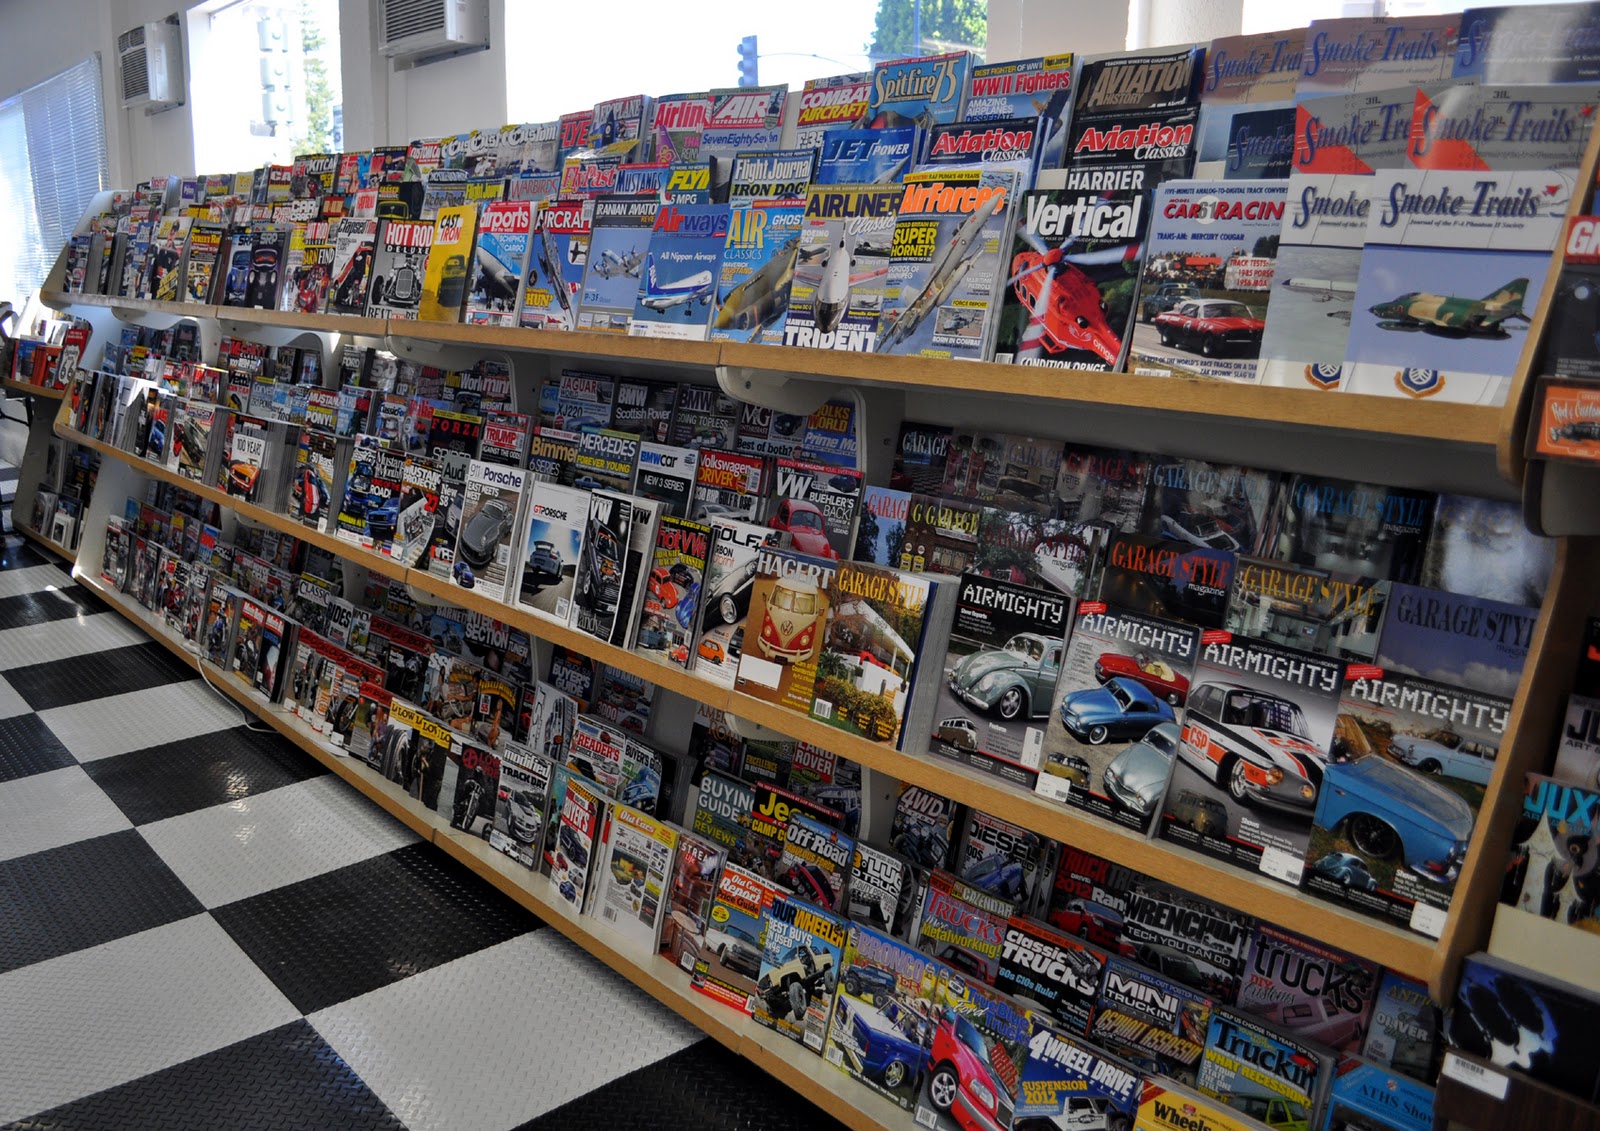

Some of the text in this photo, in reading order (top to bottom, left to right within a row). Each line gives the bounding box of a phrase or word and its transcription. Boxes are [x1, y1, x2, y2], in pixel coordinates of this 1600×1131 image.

[1305, 30, 1373, 77] Smoke
[1379, 26, 1438, 61] Trails
[974, 64, 1026, 77] BEST FIGHTER OF
[1207, 49, 1268, 92] Smoke
[872, 60, 960, 108] Spitfire 75
[972, 75, 1001, 97] WW
[1015, 71, 1070, 95] Fighters
[1088, 60, 1190, 108] AVIATION
[721, 93, 768, 119] AIR
[966, 105, 1014, 116] AIRPLANES
[969, 97, 1008, 108] AMAZING
[1103, 92, 1144, 105] HISTORY
[1075, 122, 1194, 153] Aviation
[1300, 116, 1370, 165] Smoke
[1413, 101, 1576, 156] Smoke Trails
[824, 138, 909, 162] JET POWER
[931, 129, 1033, 156] Aviation
[981, 146, 1027, 163] Classics
[1134, 144, 1187, 161] Classics
[560, 164, 617, 193] FlyPast
[735, 156, 812, 183] Flight Journal
[1068, 170, 1144, 190] HARRIER
[676, 194, 698, 204] MPG
[733, 182, 767, 197] IRON
[1027, 195, 1143, 238] Vertical
[1163, 201, 1200, 220] CAR
[1292, 185, 1371, 229] Smoke
[1380, 181, 1539, 228] Smoke Trails
[440, 213, 461, 229] CAST
[480, 208, 529, 232] airports
[653, 204, 730, 234] Airways
[725, 208, 768, 249] AIR
[386, 223, 434, 247] HOT ROD
[440, 226, 460, 241] IRON
[893, 227, 937, 245] SUPER
[1190, 232, 1245, 241] MERCURY COUGAR
[387, 245, 430, 255] DELUXE
[504, 243, 525, 253] CARGO
[660, 252, 717, 263] All Nippon Airways
[723, 249, 763, 261] CLASSICS
[890, 244, 936, 257] HORNET?
[1229, 259, 1248, 267] TRACK
[785, 318, 815, 328] HAWKER
[837, 321, 871, 333] SIDDELEY
[783, 325, 879, 353] TRIDENT
[932, 336, 981, 346] BORN IN COMBAT
[59, 361, 73, 383] 66
[1020, 356, 1071, 371] CONDITION
[561, 377, 597, 394] JAGUAR
[618, 387, 648, 407] BMW
[305, 409, 333, 425] PONY!
[557, 402, 583, 418] XJ220
[616, 406, 672, 421] Scottish Power
[431, 417, 479, 438] FORZA
[580, 431, 638, 457] MERCEDES
[737, 436, 793, 457] Best of both?
[902, 431, 950, 457] GARAGE
[443, 462, 466, 481] Audi
[535, 459, 560, 477] SERIES
[577, 454, 630, 475] FOREVER YOUNG
[697, 466, 733, 487] DRIVER
[699, 453, 751, 478] Volkswagen
[468, 481, 500, 497] EAST MEETS
[483, 466, 522, 488] Porsche
[643, 474, 685, 492] NEW 3 SERIES
[776, 471, 813, 500] VW
[466, 490, 481, 502] WEST
[809, 491, 855, 509] BUEHLER'S
[924, 501, 980, 534] GARAGE
[1111, 540, 1230, 590] GARAGE STYLE
[838, 568, 925, 612] GARAGE STYLE
[1187, 582, 1225, 598] magazine
[1243, 564, 1376, 617] GARAGE STYLE
[963, 583, 1063, 625] AIRMIGHTY
[1081, 612, 1193, 657] AIRMIGHTY
[552, 664, 591, 688] BUYER'S
[1203, 641, 1338, 692] AIRMIGHTY
[554, 678, 584, 698] GUIDE
[1351, 677, 1509, 734] AIRMIGHTY
[578, 733, 620, 761] READER'S
[1189, 723, 1208, 751] CSP
[503, 749, 550, 777] modified
[795, 750, 832, 775] ROVER
[502, 766, 547, 791] TRACK DAY
[696, 811, 713, 824] 275
[698, 794, 740, 823] GUIDE
[619, 808, 656, 834] Old Cars
[694, 818, 737, 847] REVIEWS
[787, 822, 850, 868] Off-Road
[768, 917, 814, 946] BEST BUYS
[921, 921, 1001, 960] Metalworking!
[857, 932, 925, 981] BRONCO
[1127, 925, 1231, 967] TECH YOU CAN DO
[1001, 940, 1098, 997] TRUCKS
[1034, 979, 1058, 1000] Rule!
[1107, 971, 1180, 1014] MINI
[1022, 1080, 1088, 1093] SUSPENSION
[1093, 1061, 1136, 1096] DRIVE
[1204, 1049, 1312, 1111] WHAT RECESSION?
[1024, 1090, 1058, 1105] 2012
